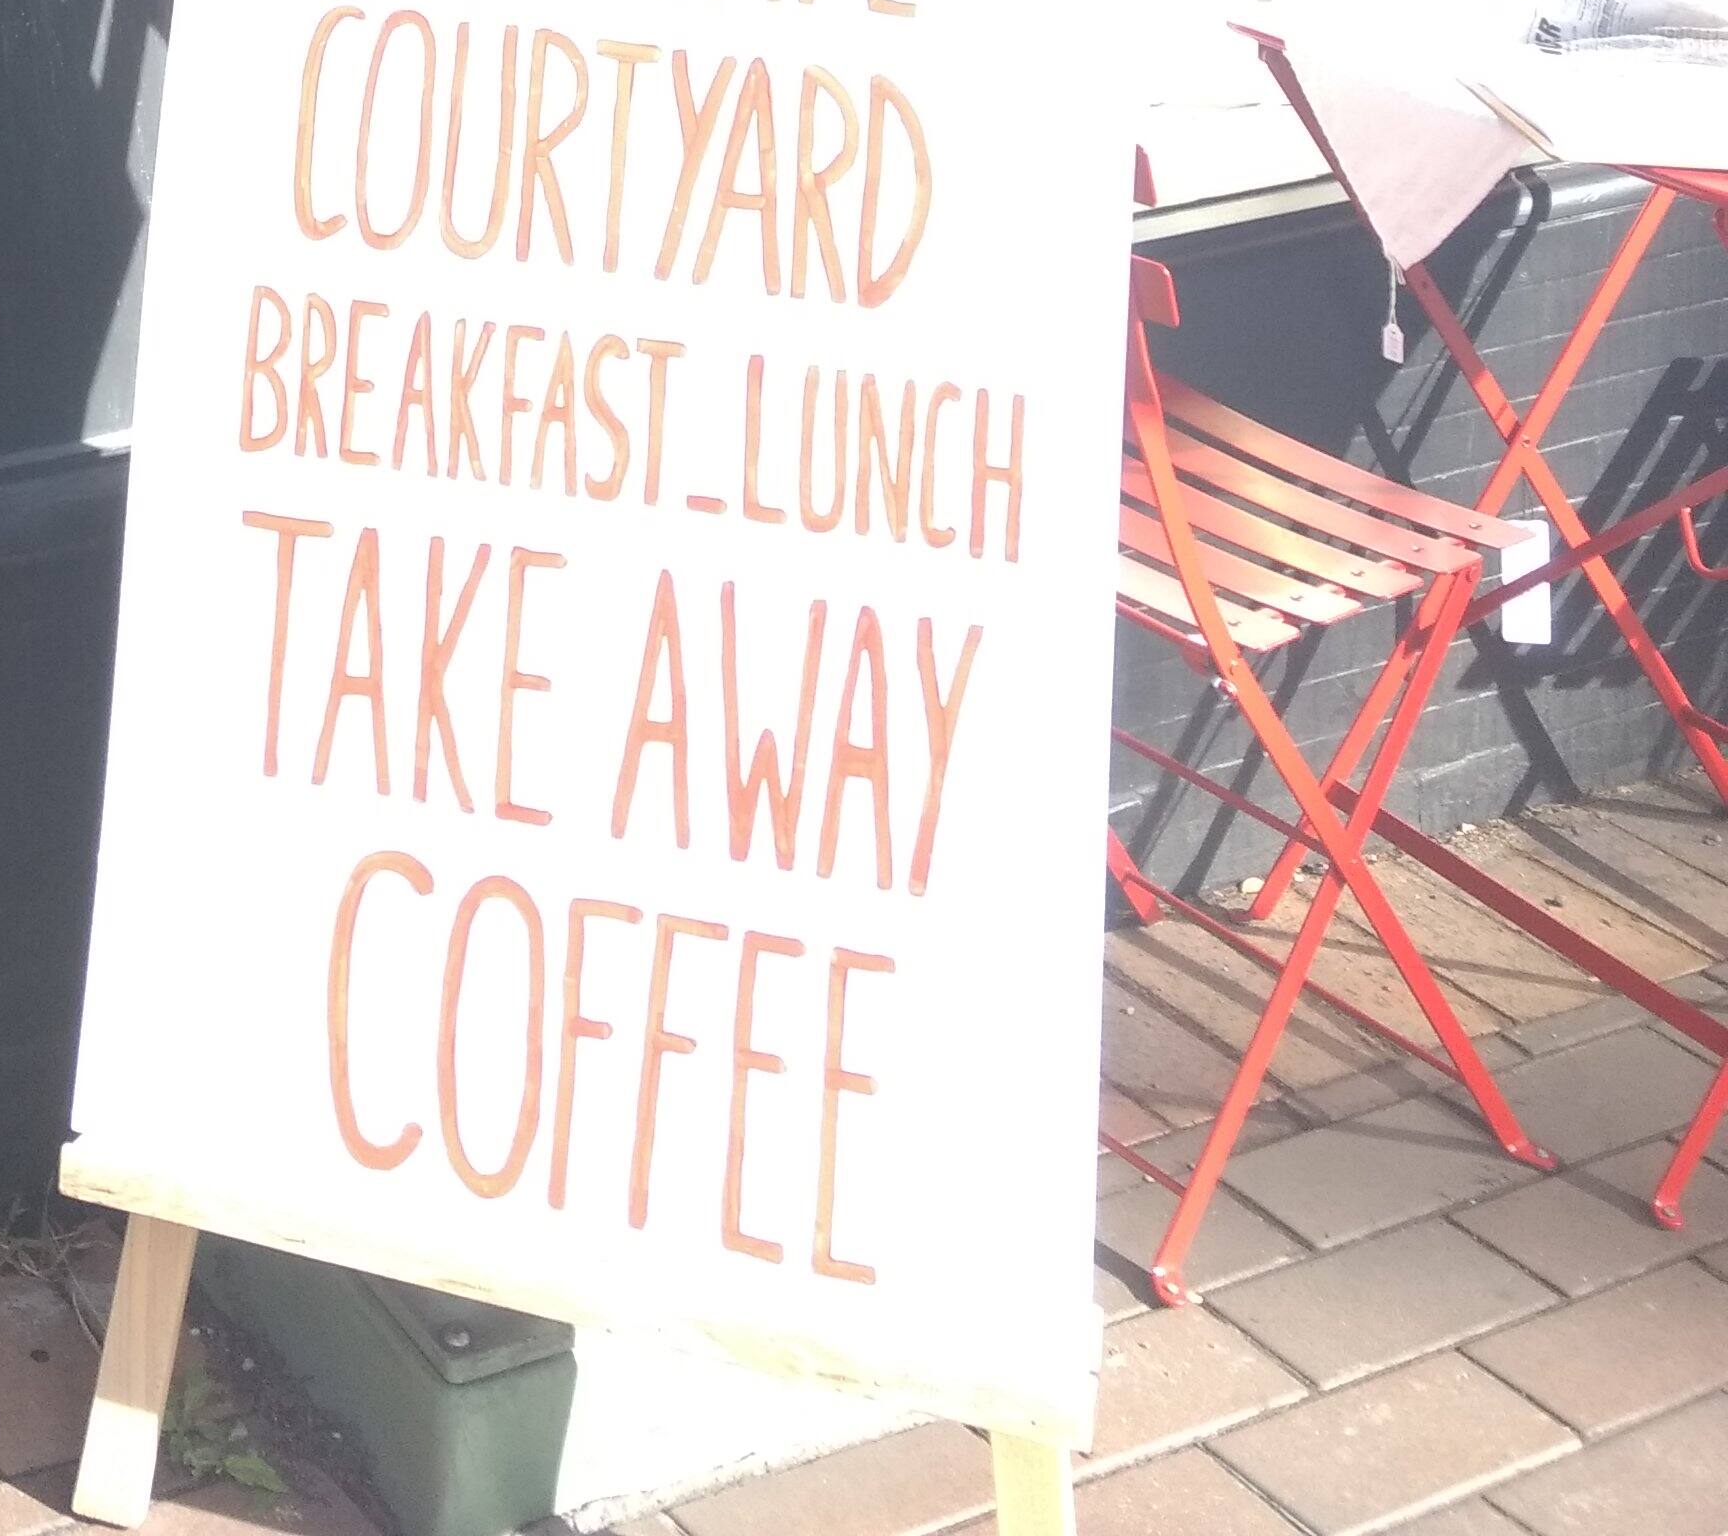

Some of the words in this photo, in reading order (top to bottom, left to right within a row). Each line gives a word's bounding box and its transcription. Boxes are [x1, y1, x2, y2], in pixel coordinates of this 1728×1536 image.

[293, 4, 933, 309] COURTYARD
[241, 510, 568, 826] TAKE
[610, 568, 984, 898] AWAY
[326, 850, 896, 1285] COFFEE
